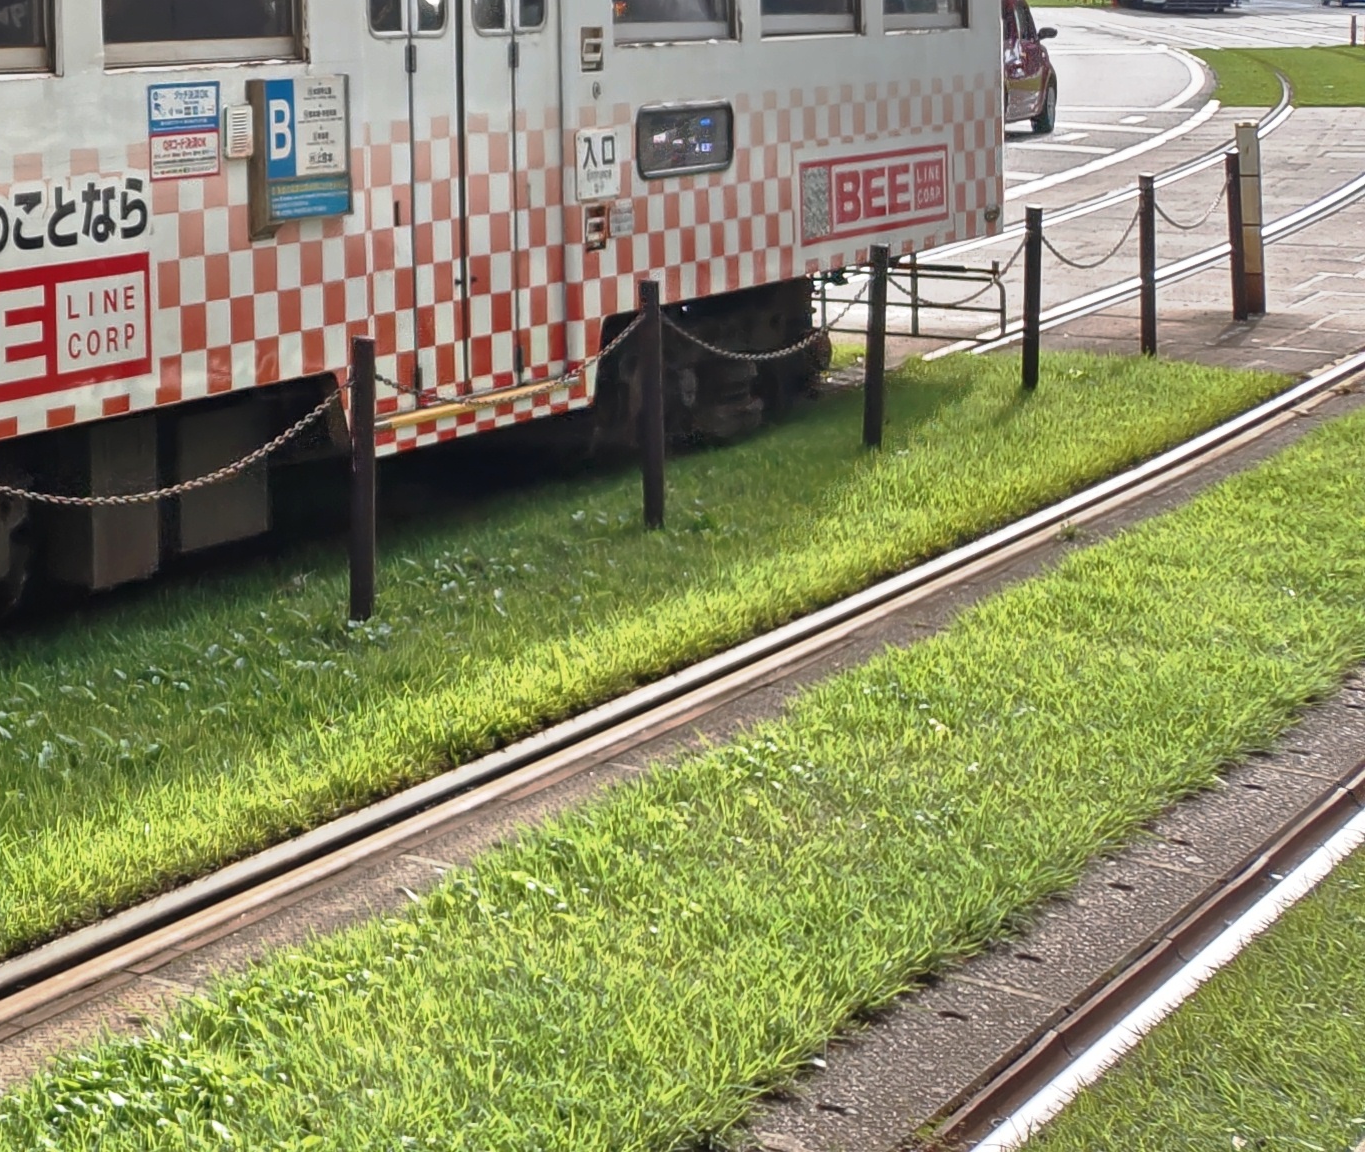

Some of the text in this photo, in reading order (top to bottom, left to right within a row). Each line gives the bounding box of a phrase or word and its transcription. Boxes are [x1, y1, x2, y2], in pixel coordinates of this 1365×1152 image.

[268, 98, 293, 161] B
[583, 135, 615, 170] 入口
[916, 165, 940, 184] LINE
[835, 163, 911, 225] BEE
[67, 285, 135, 319] LINE
[68, 323, 135, 360] CORP
